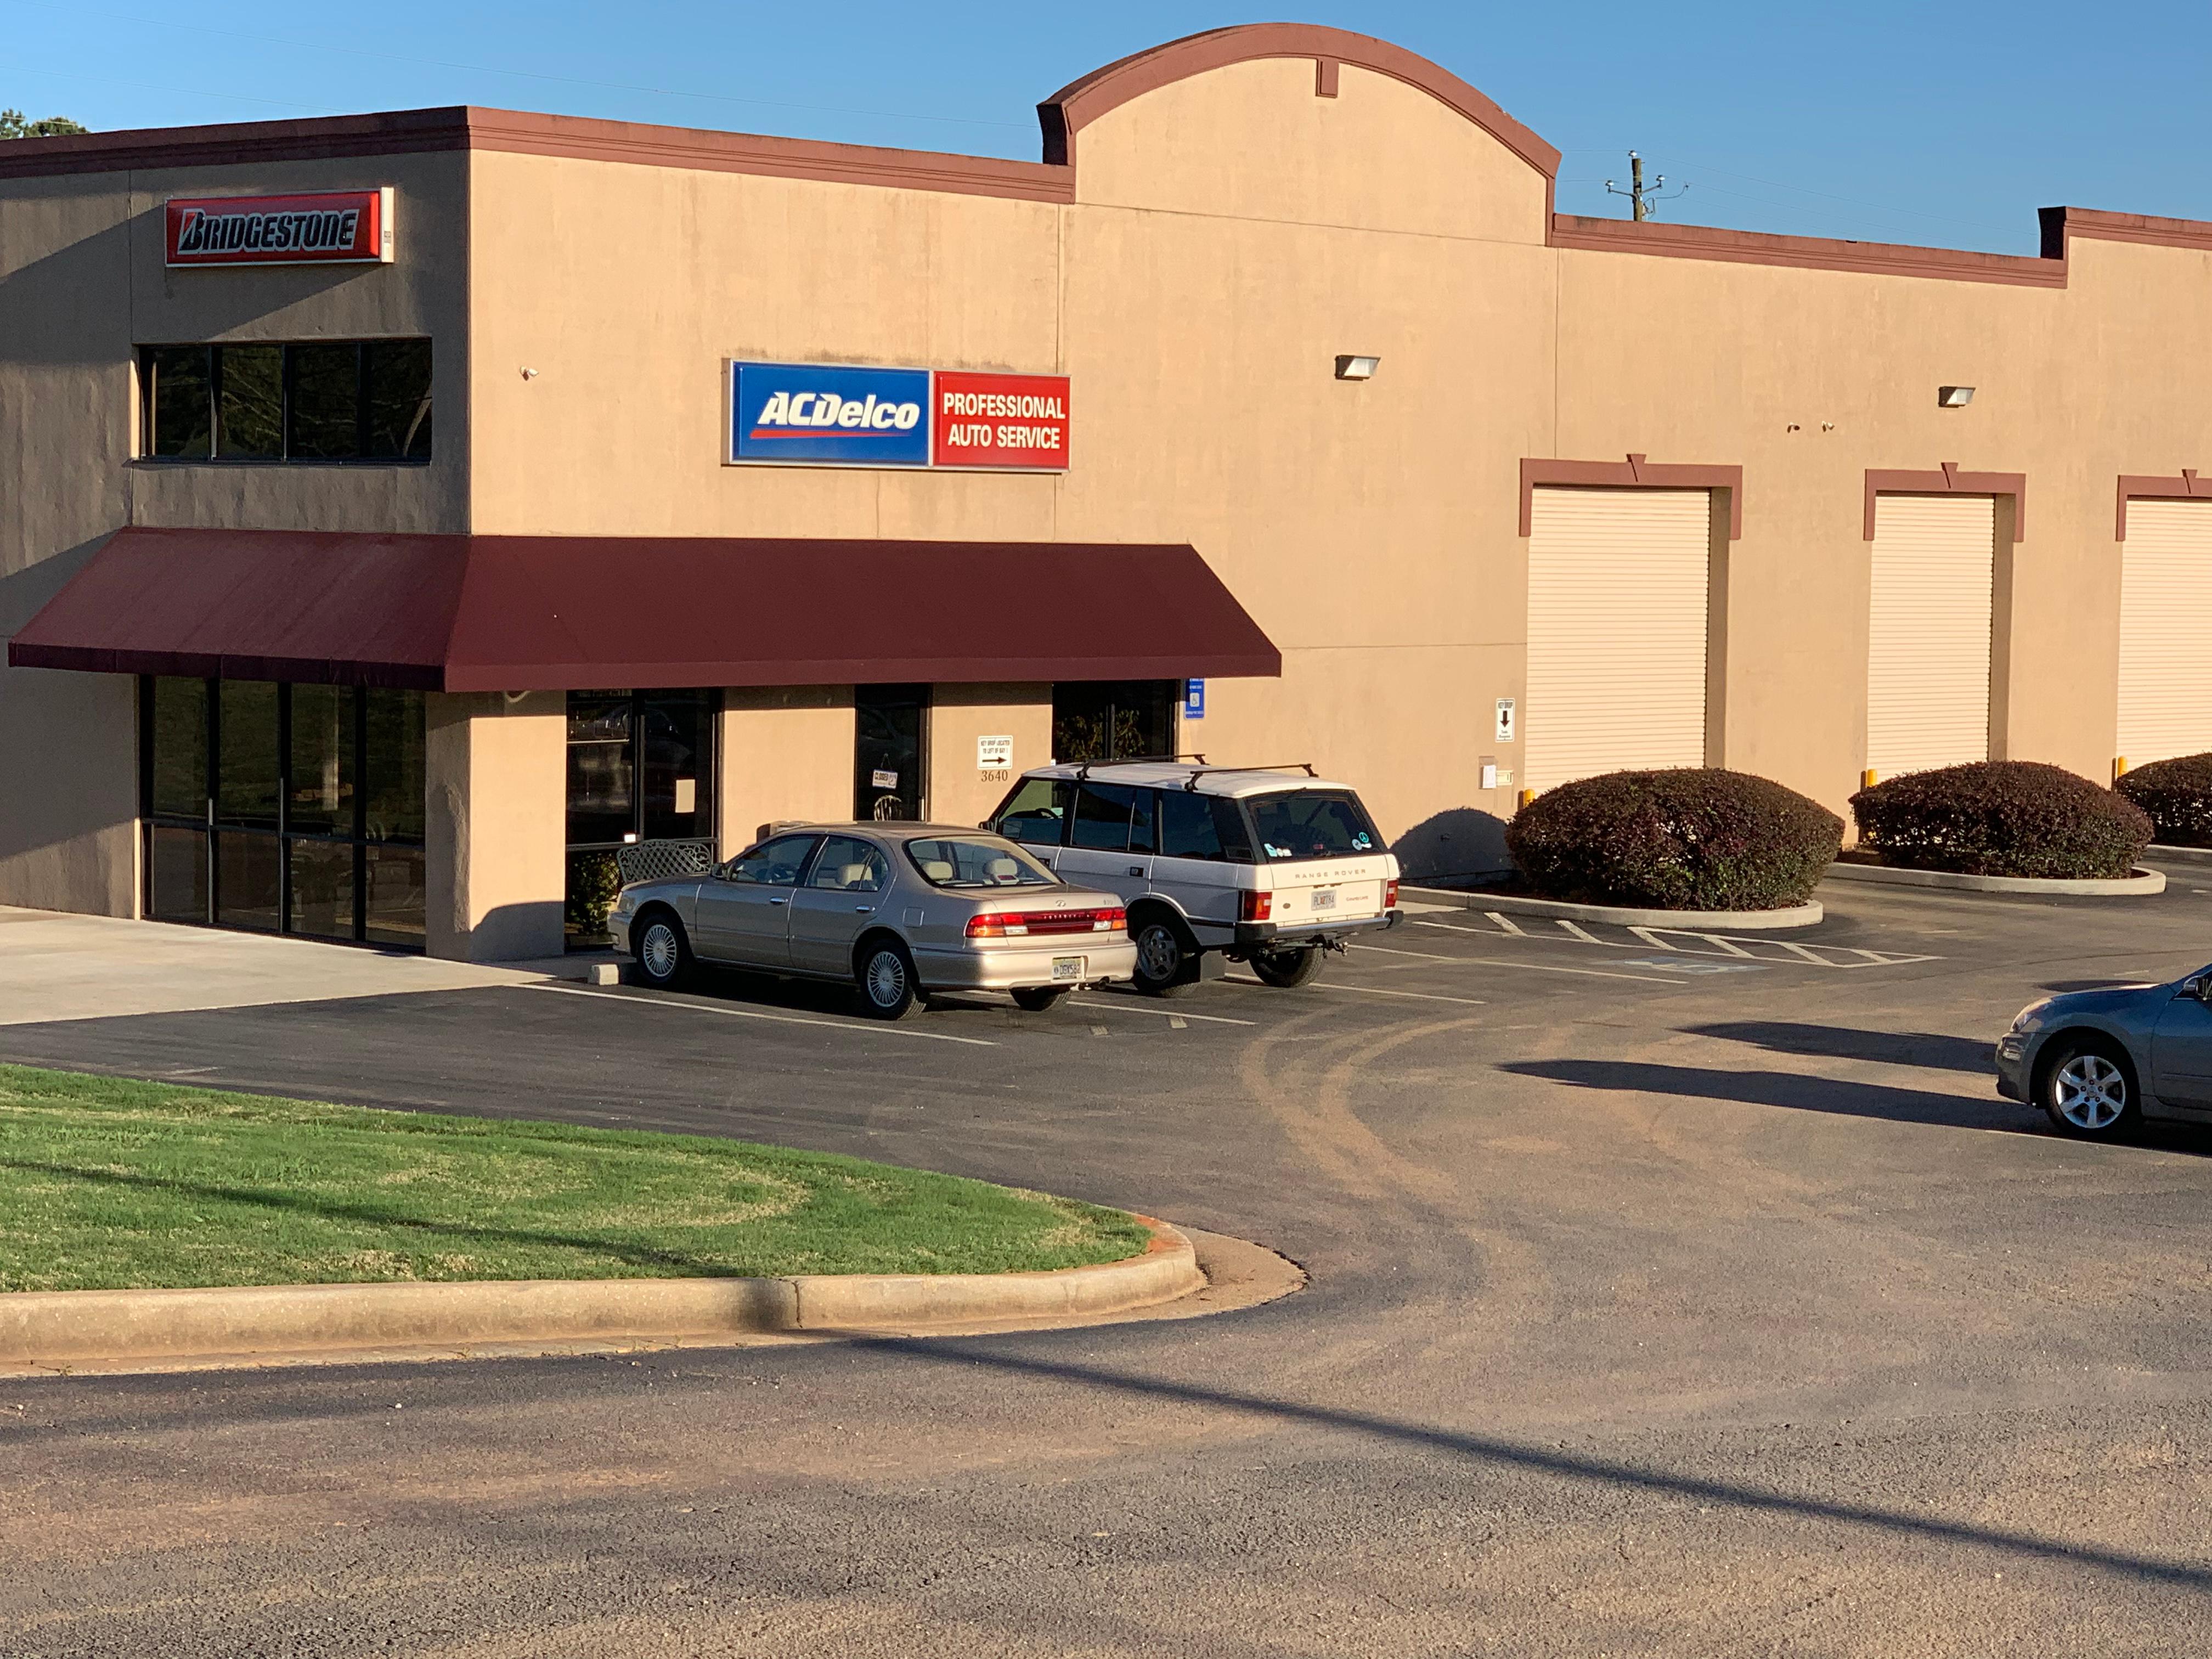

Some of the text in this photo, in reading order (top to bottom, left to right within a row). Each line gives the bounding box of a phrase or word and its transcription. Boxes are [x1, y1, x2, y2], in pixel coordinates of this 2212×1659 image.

[177, 208, 359, 255] BRIDGESTONE
[758, 392, 920, 430] ACDelco
[943, 392, 1065, 419] PROFESSIONAL
[948, 424, 1060, 449] AUTO SERVICE
[981, 770, 1008, 782] 3640
